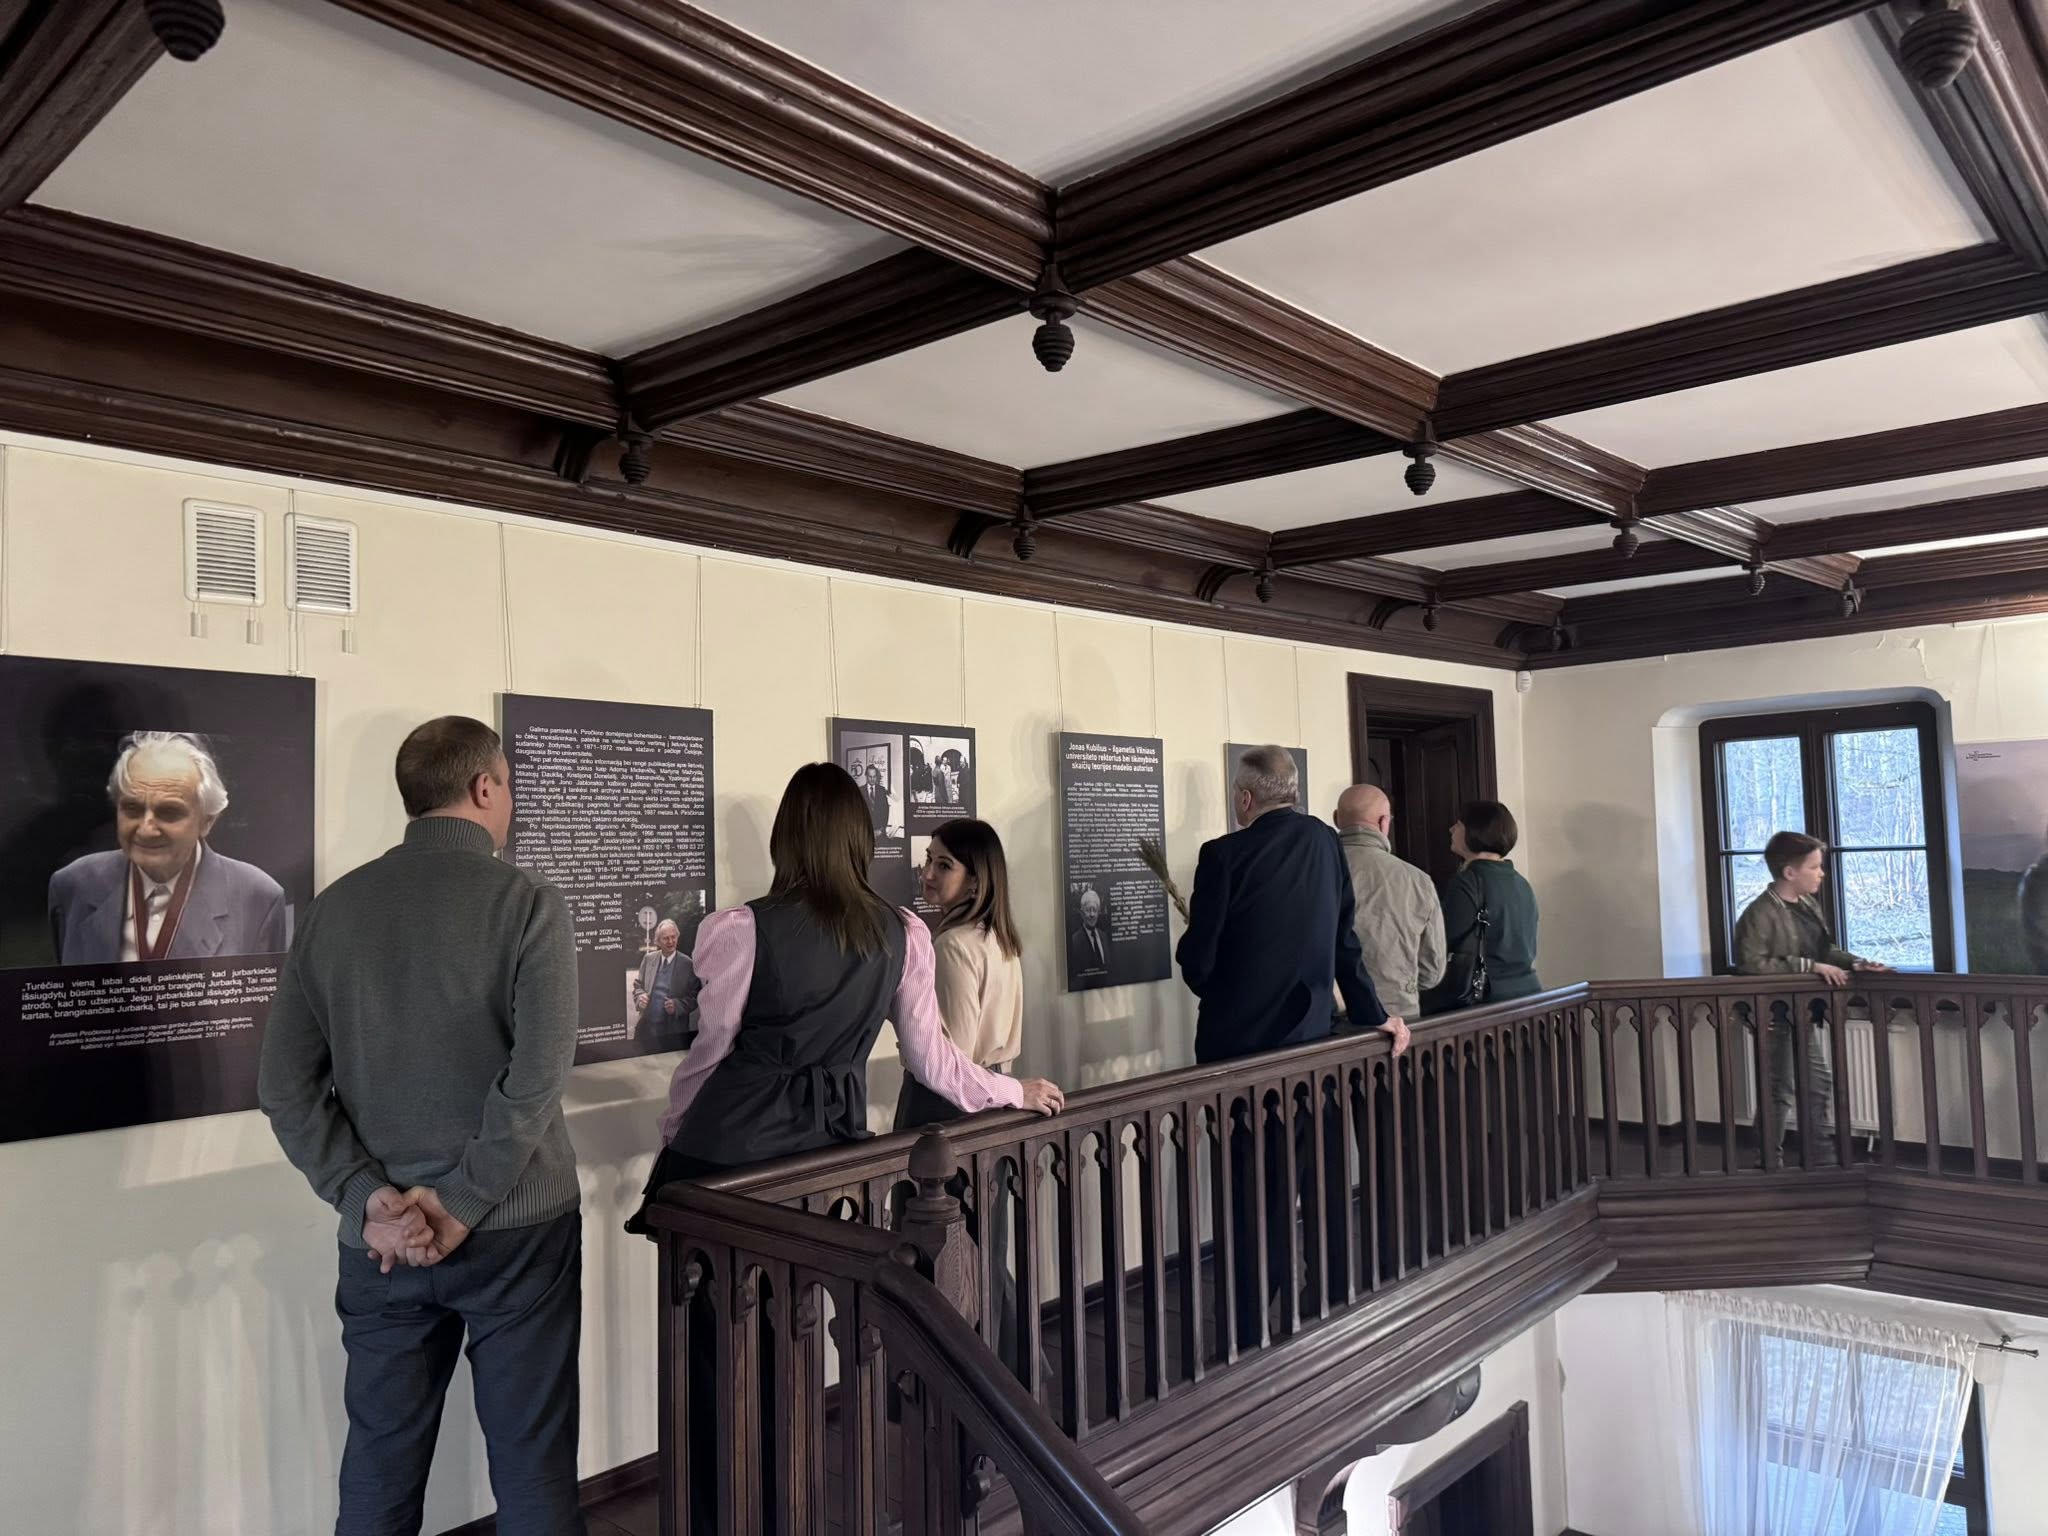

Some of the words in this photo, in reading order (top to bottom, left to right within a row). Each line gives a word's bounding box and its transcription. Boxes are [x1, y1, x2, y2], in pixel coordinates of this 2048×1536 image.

[1069, 742, 1085, 750] Jonas
[1092, 763, 1111, 772] teorijos
[72, 979, 95, 988] vieną
[102, 977, 123, 985] labai
[130, 974, 152, 984] didelį
[212, 970, 226, 978] kad
[232, 967, 277, 978] jurbarkiečiai
[22, 992, 66, 1001] išsiugdytų
[70, 988, 106, 997] būsimas
[109, 986, 137, 994] kartas,
[141, 983, 165, 992] kurios
[168, 981, 206, 990] brangintų
[22, 1002, 53, 1011] atrodo,
[58, 999, 74, 1008] kad
[131, 993, 152, 1003] Jeigu
[156, 990, 203, 1001] jurbarkiškiai
[207, 988, 242, 997] išsiugdys
[246, 985, 277, 993] būsimas
[22, 1012, 52, 1020] kartas,
[54, 1006, 115, 1018] branginančias
[169, 1001, 179, 1010] jie
[198, 998, 218, 1006] atlikę
